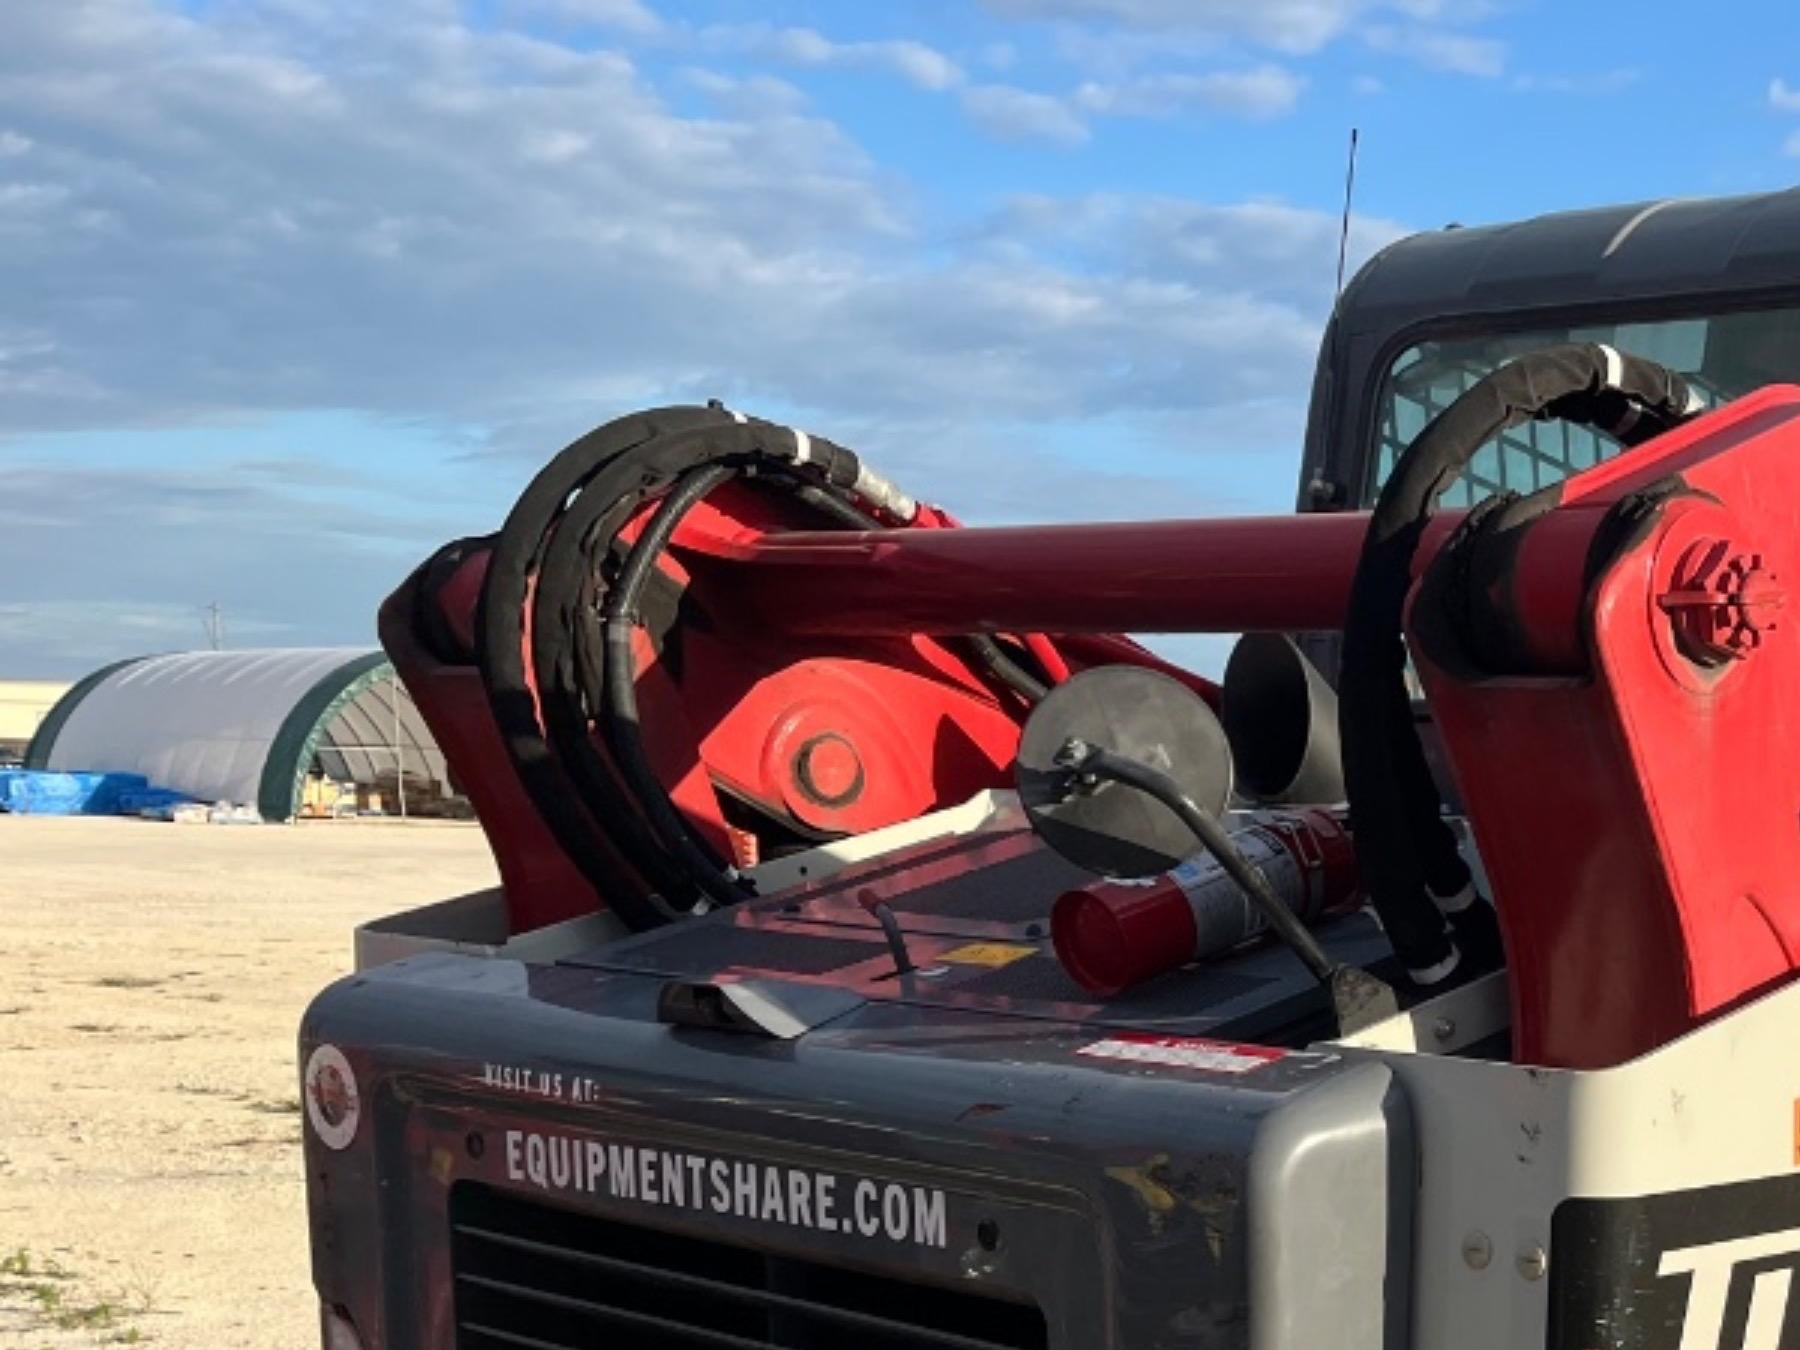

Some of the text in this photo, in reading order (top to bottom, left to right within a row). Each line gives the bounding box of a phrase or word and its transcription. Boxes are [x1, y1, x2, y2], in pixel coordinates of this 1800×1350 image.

[485, 1062, 599, 1103] VISIT US AT:
[505, 1130, 947, 1248] EQUIPMENTSHARE.COM
